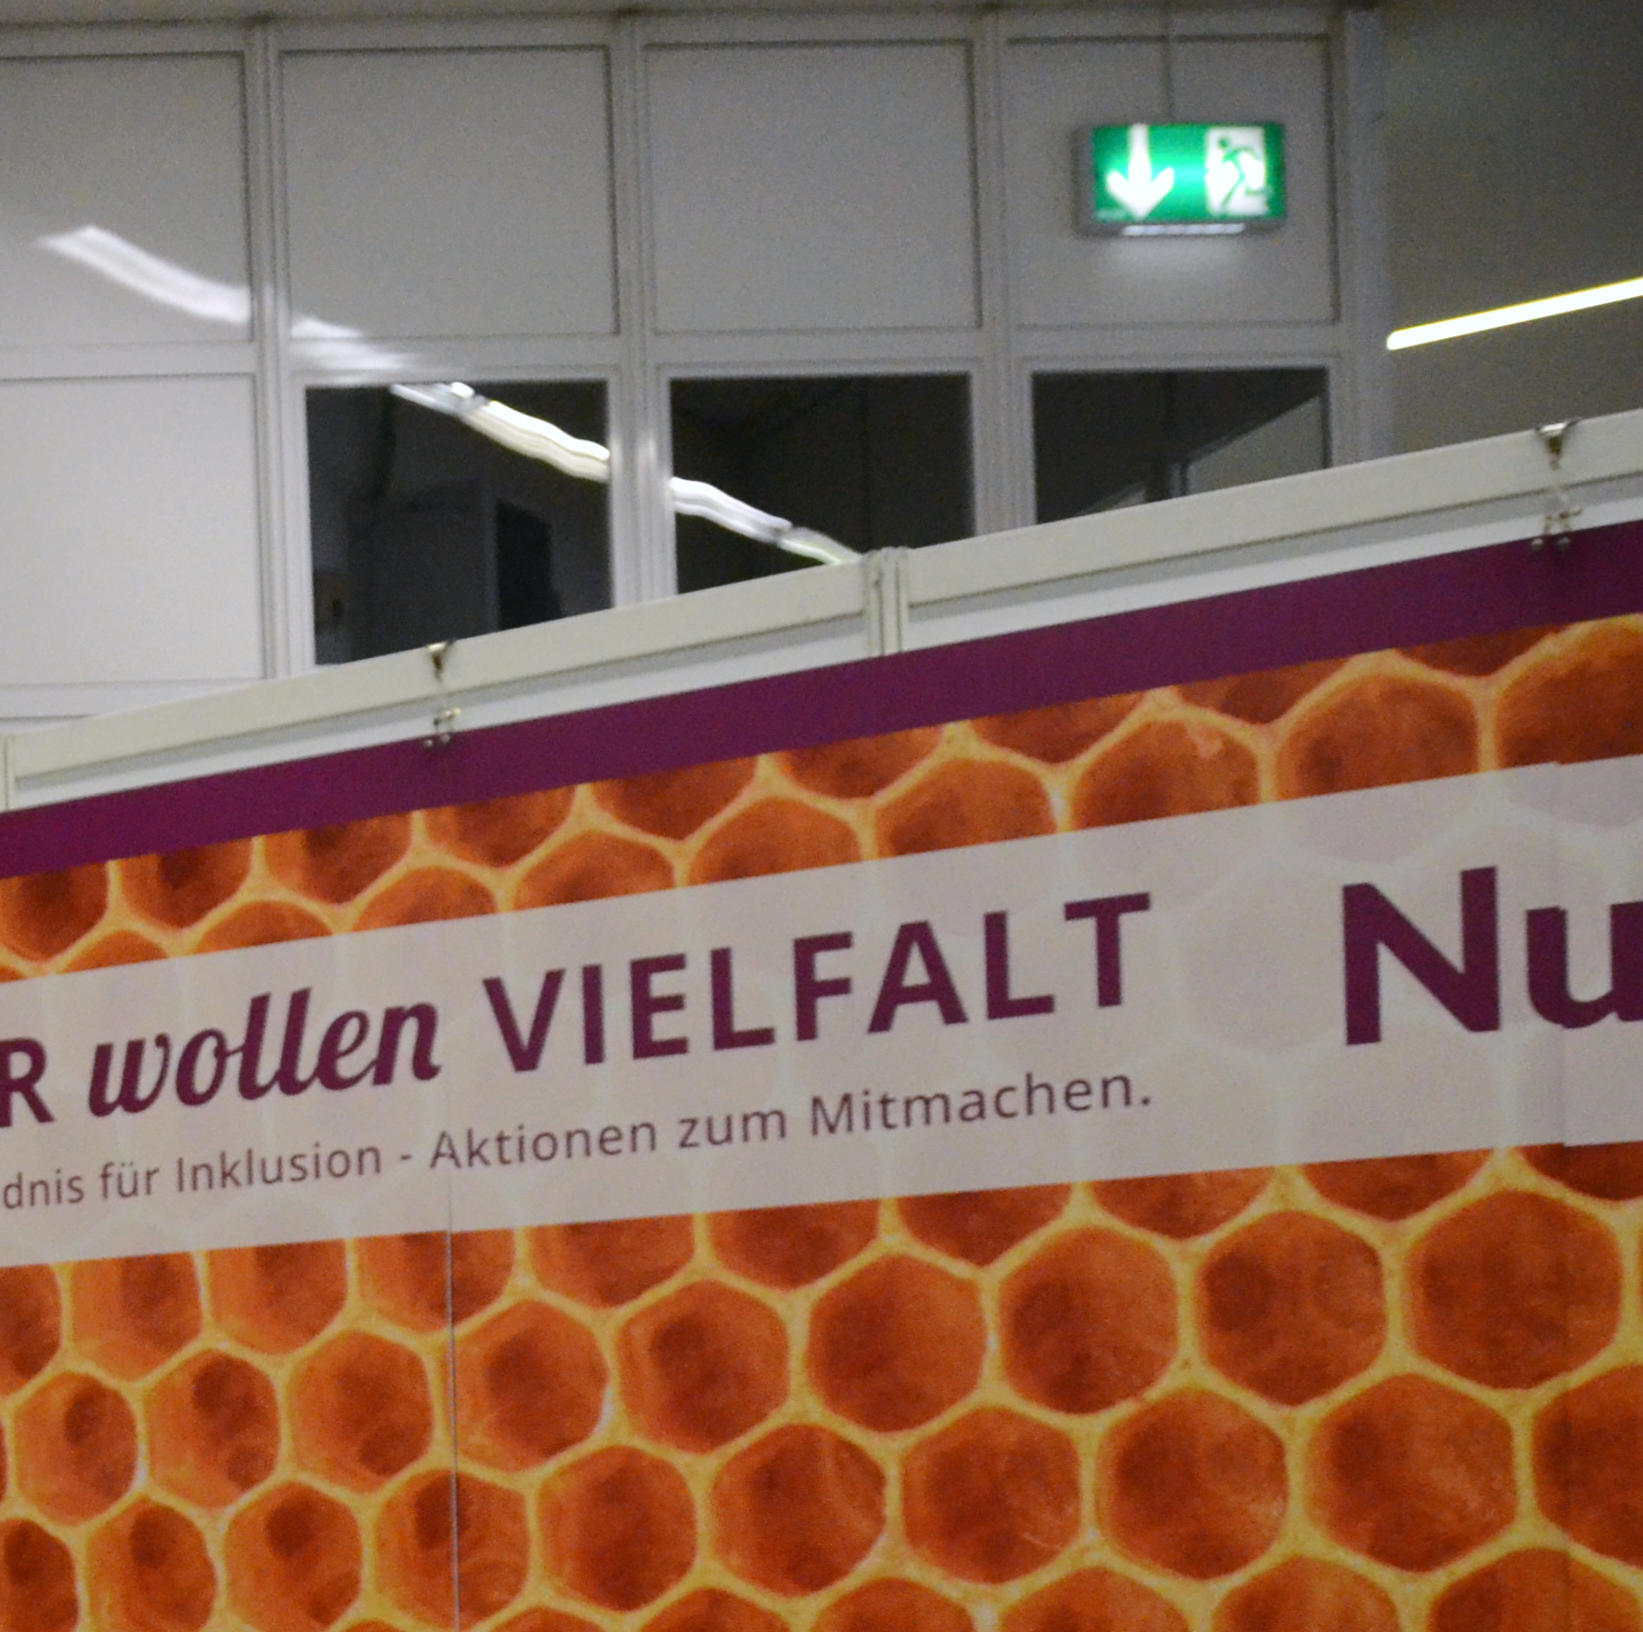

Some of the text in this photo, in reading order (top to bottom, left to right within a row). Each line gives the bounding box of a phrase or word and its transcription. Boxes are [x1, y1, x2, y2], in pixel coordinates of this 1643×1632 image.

[86, 986, 442, 1118] wollen
[481, 891, 1151, 1074] VIELFALT
[99, 1162, 161, 1199] für
[175, 1141, 382, 1194] Inklusion
[429, 1117, 658, 1171] Aktionen
[677, 1105, 788, 1150] zum
[810, 1072, 1152, 1137] Mitmachen.
